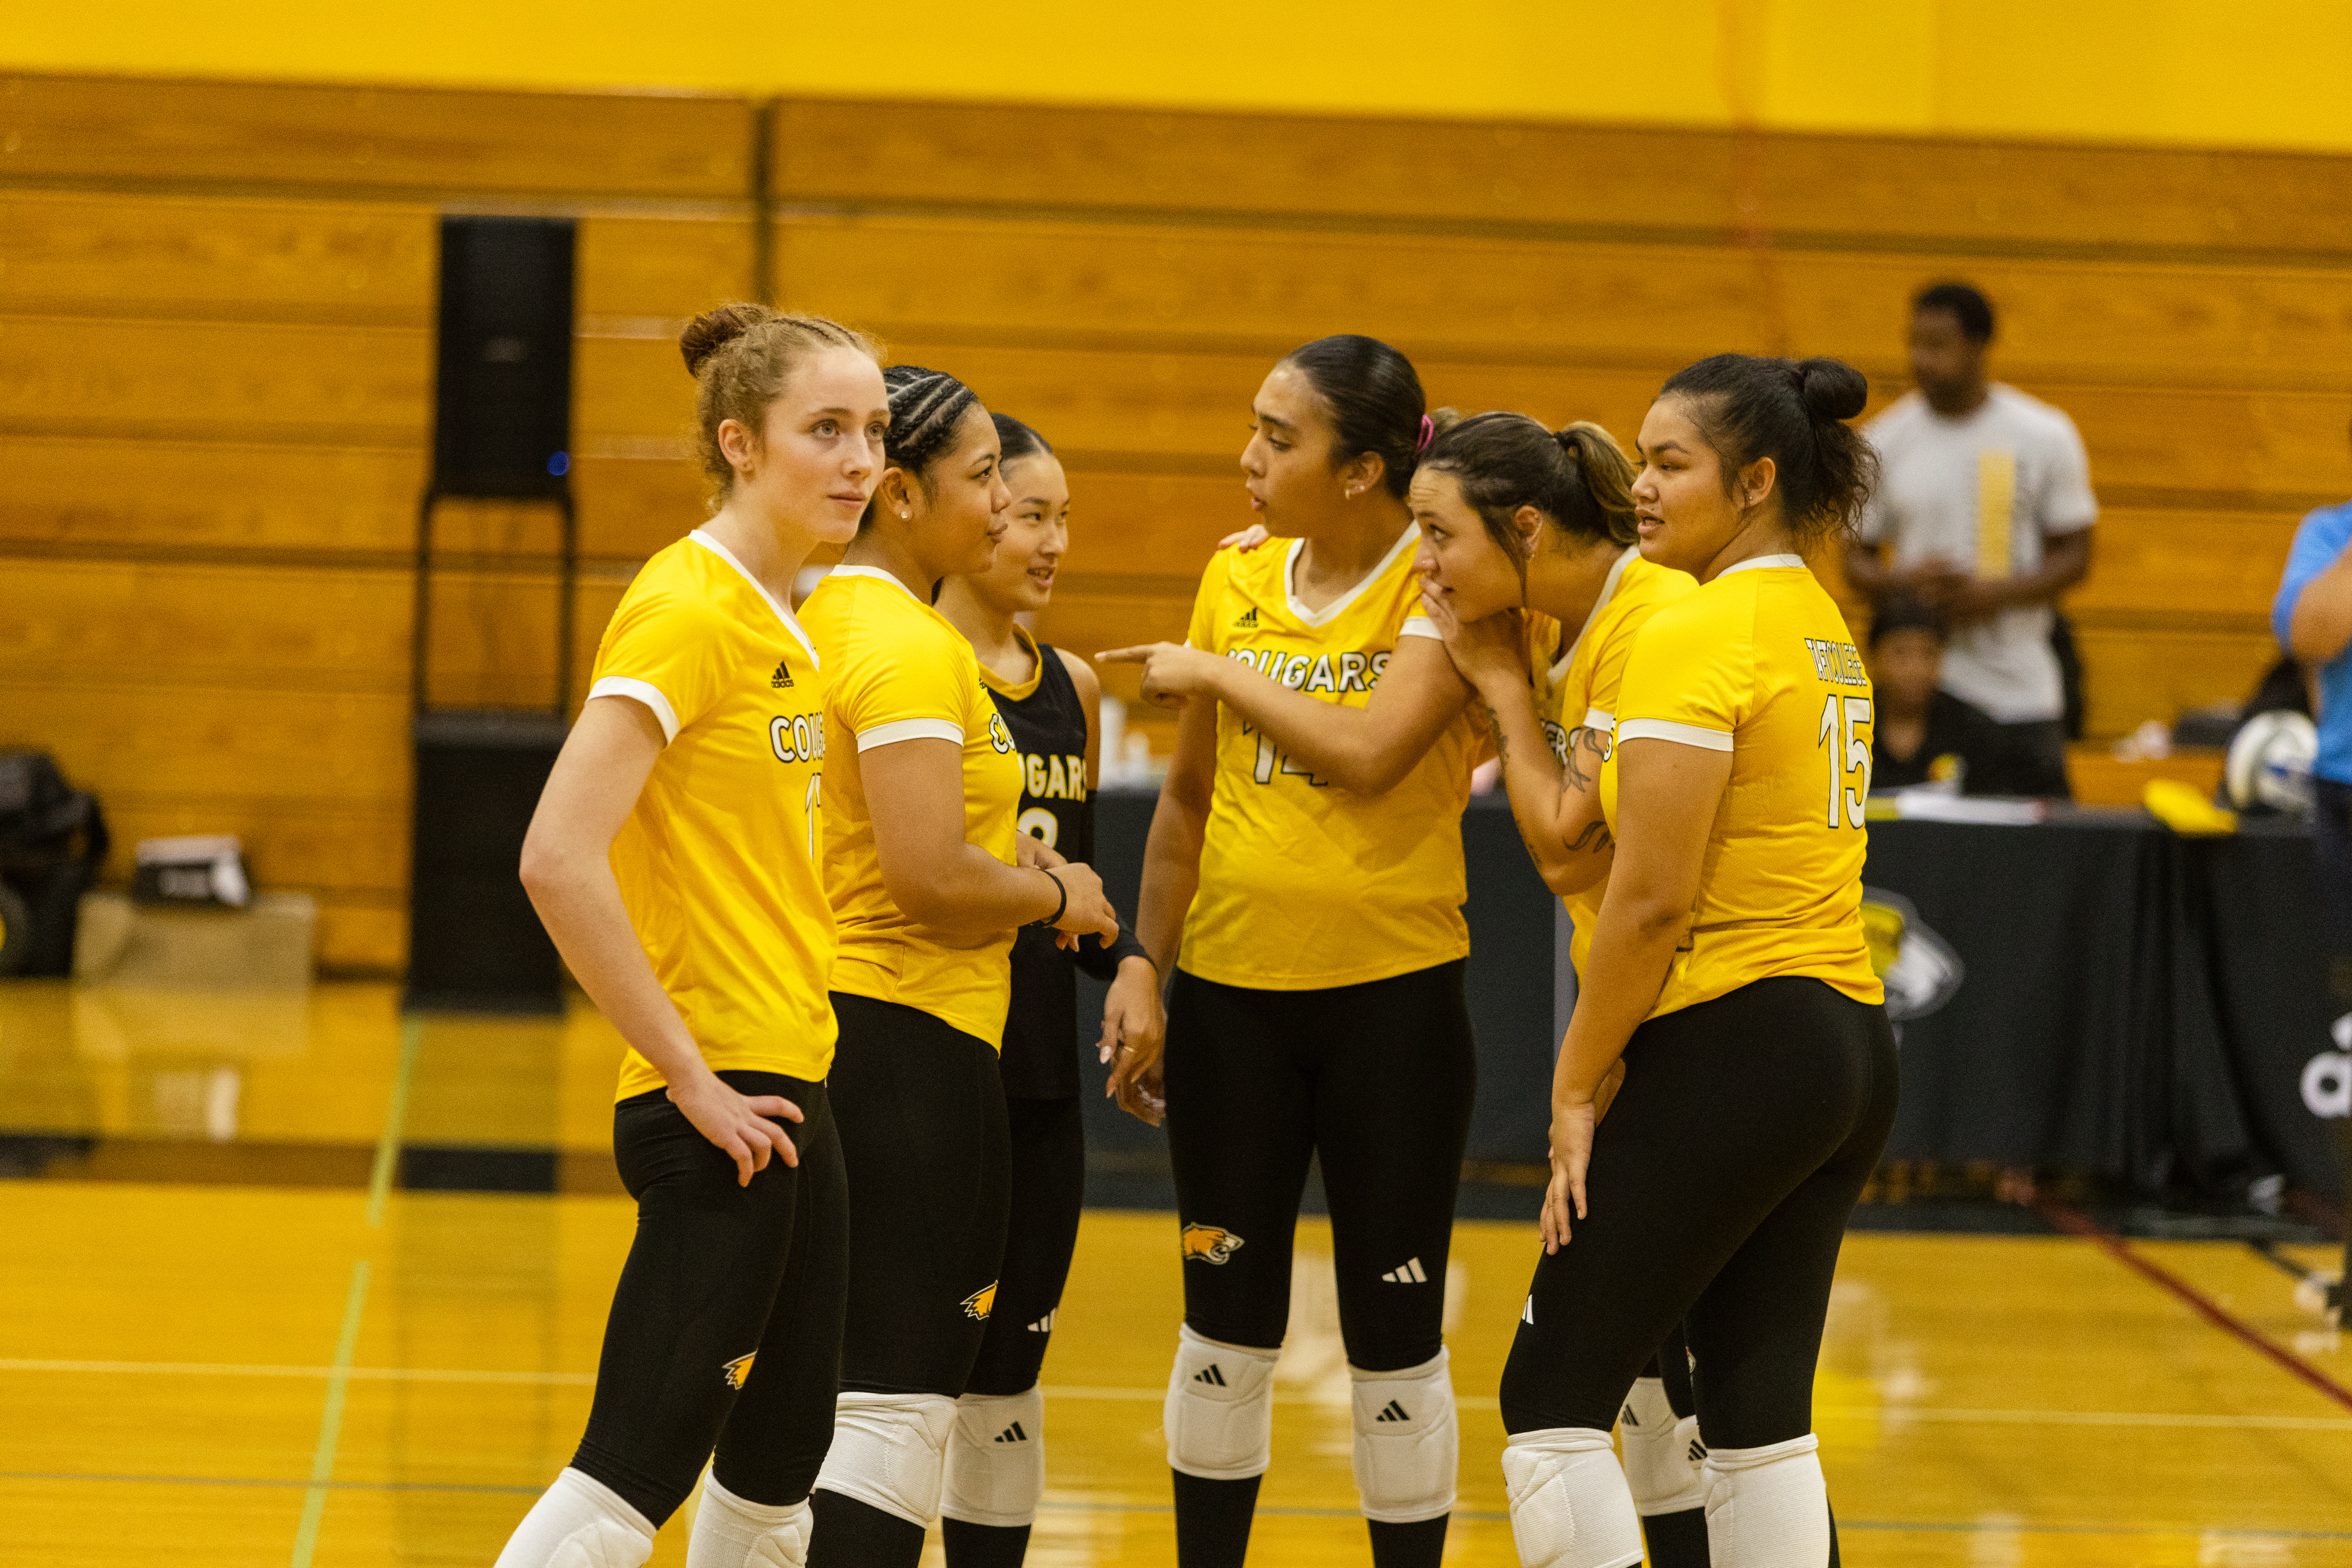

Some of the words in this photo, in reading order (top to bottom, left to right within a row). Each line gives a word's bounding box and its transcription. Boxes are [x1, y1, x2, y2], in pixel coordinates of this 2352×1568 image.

[1804, 637, 1833, 682] TAFT
[1826, 640, 1867, 686] COLLEGE
[1818, 694, 1871, 829] 15
